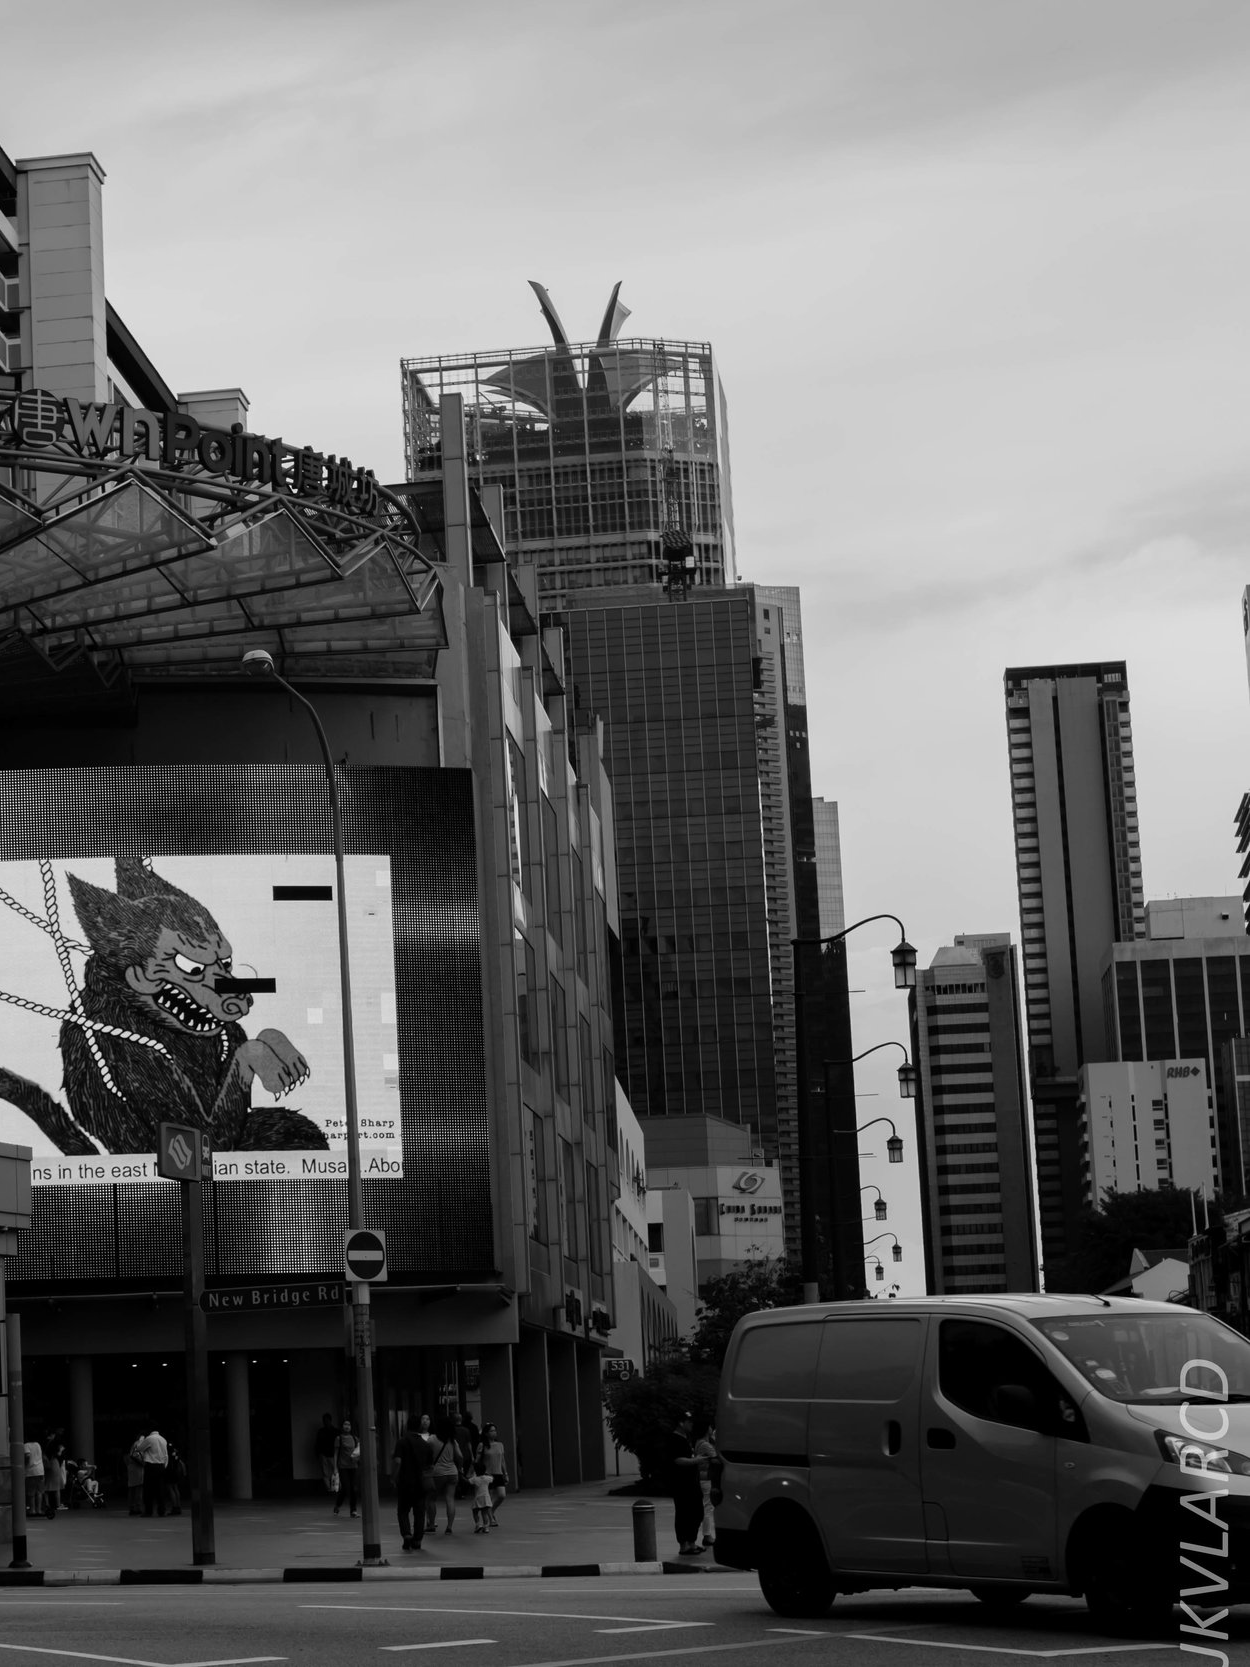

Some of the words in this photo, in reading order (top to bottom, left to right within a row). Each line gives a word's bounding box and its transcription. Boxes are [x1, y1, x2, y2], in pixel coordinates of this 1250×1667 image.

[1166, 1066, 1190, 1079] RHB
[361, 1118, 395, 1128] Sharp
[58, 1164, 72, 1179] in
[79, 1163, 105, 1179] the
[111, 1162, 148, 1178] east
[244, 1159, 290, 1175] state.
[209, 1293, 243, 1308] New
[251, 1289, 311, 1306] Bridge
[318, 1285, 339, 1300] Rd
[611, 1361, 629, 1371] 531
